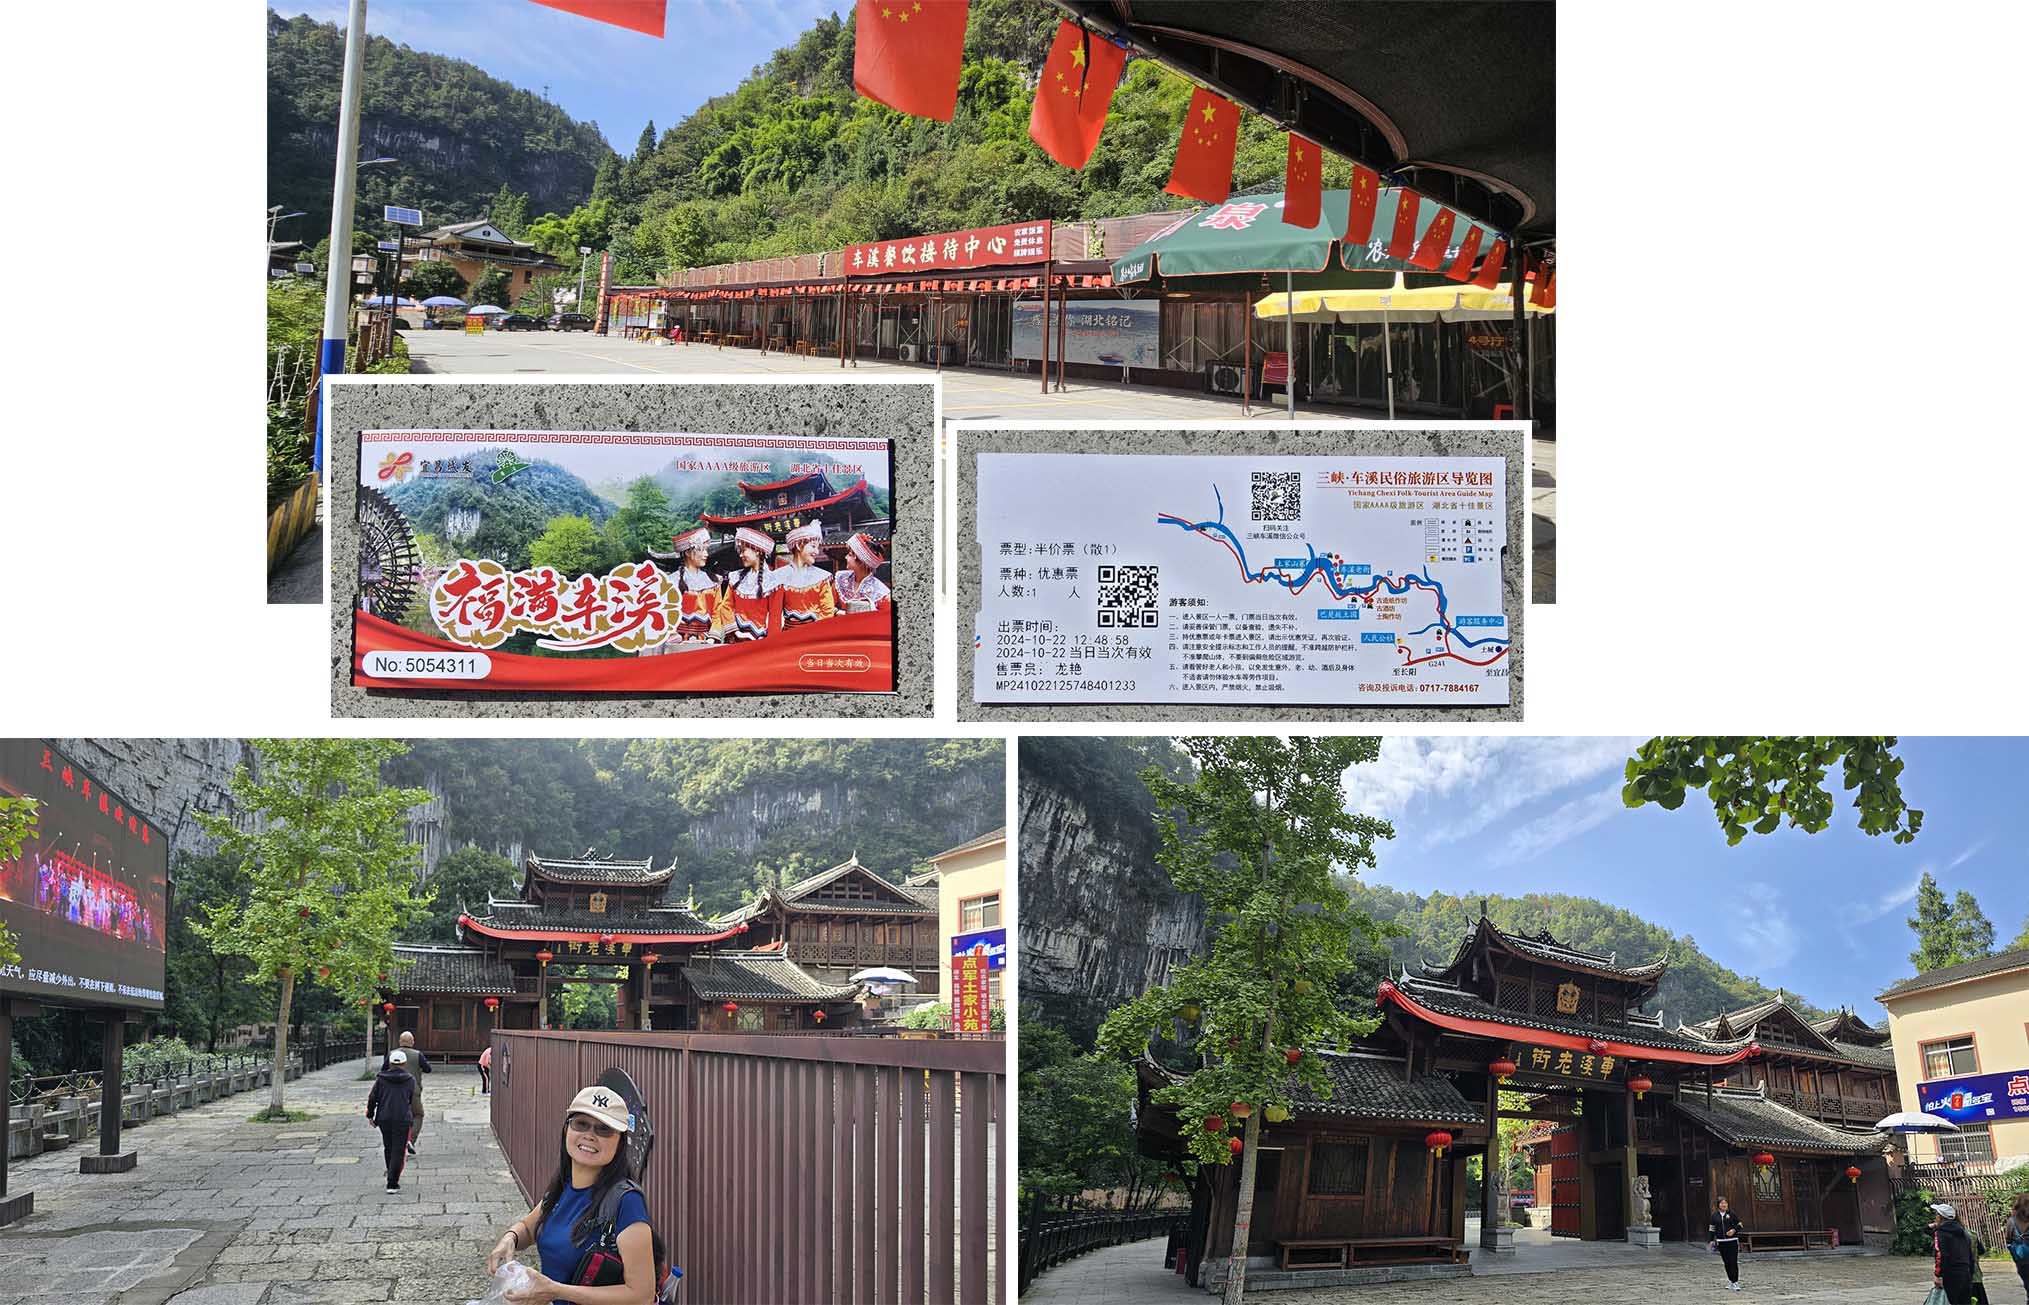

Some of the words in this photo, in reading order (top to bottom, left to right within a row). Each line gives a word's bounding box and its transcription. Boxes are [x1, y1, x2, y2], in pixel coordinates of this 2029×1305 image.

[852, 235, 1007, 269] 车溪餐饮接待中心
[676, 460, 770, 473] 国家AAAA级旅游区
[790, 463, 864, 473] 湖北省十佳景区
[1316, 471, 1493, 486] 三峡·车溪民俗旅游区导览图
[1478, 490, 1493, 498] Map
[1353, 500, 1425, 510] 国家AAAA级旅游区
[1432, 501, 1493, 510] 湖北省十佳景区
[1247, 532, 1306, 540] 三峡车溪微信公众号
[1068, 586, 1081, 599] 人
[440, 560, 666, 647] 福满车溪
[996, 635, 1066, 645] 2024-10-22
[1074, 635, 1129, 645] 12:48:58
[996, 648, 1066, 658] 2024-10-22
[1069, 646, 1152, 659] 当日当次有效
[806, 658, 864, 669] 当日当次有效
[1055, 663, 1083, 676] 龙艳
[1392, 668, 1417, 676] 至长阳
[996, 680, 1136, 691] MP241022125748401233
[962, 957, 979, 1031] 点军土家小苑
[592, 1094, 609, 1108] NY
